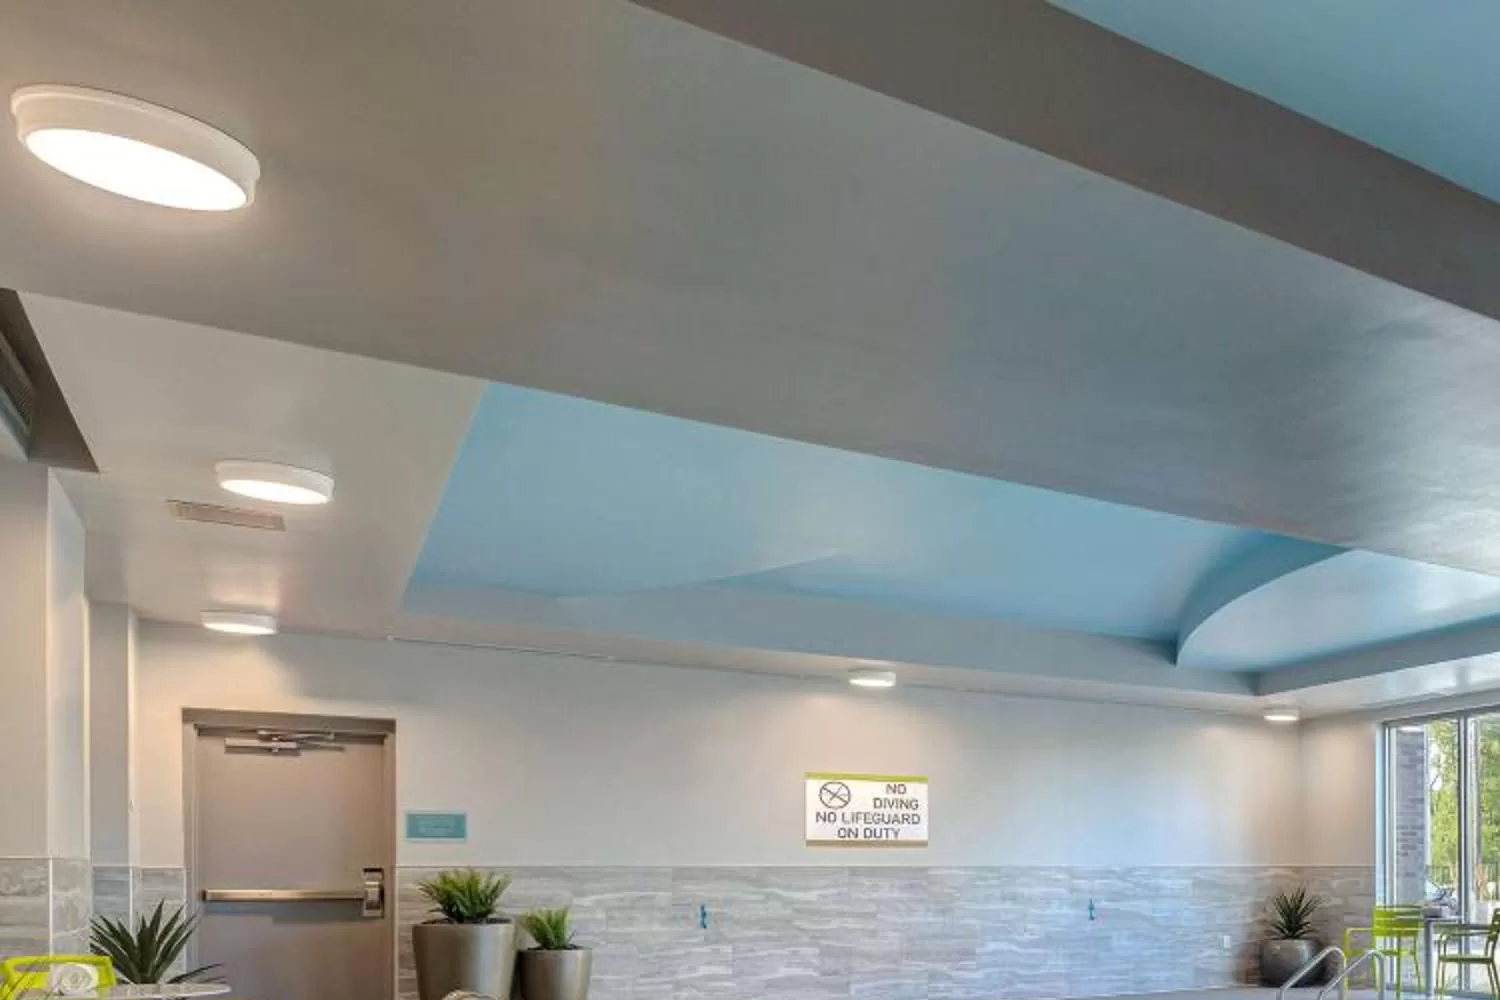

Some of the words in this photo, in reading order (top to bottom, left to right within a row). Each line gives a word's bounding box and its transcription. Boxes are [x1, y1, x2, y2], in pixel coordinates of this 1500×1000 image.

[886, 783, 907, 795] NO
[873, 797, 919, 810] DIVING
[815, 811, 837, 823] NO
[841, 811, 921, 825] LIFEGUARD
[837, 827, 859, 839] ON
[863, 827, 901, 839] DUTY
